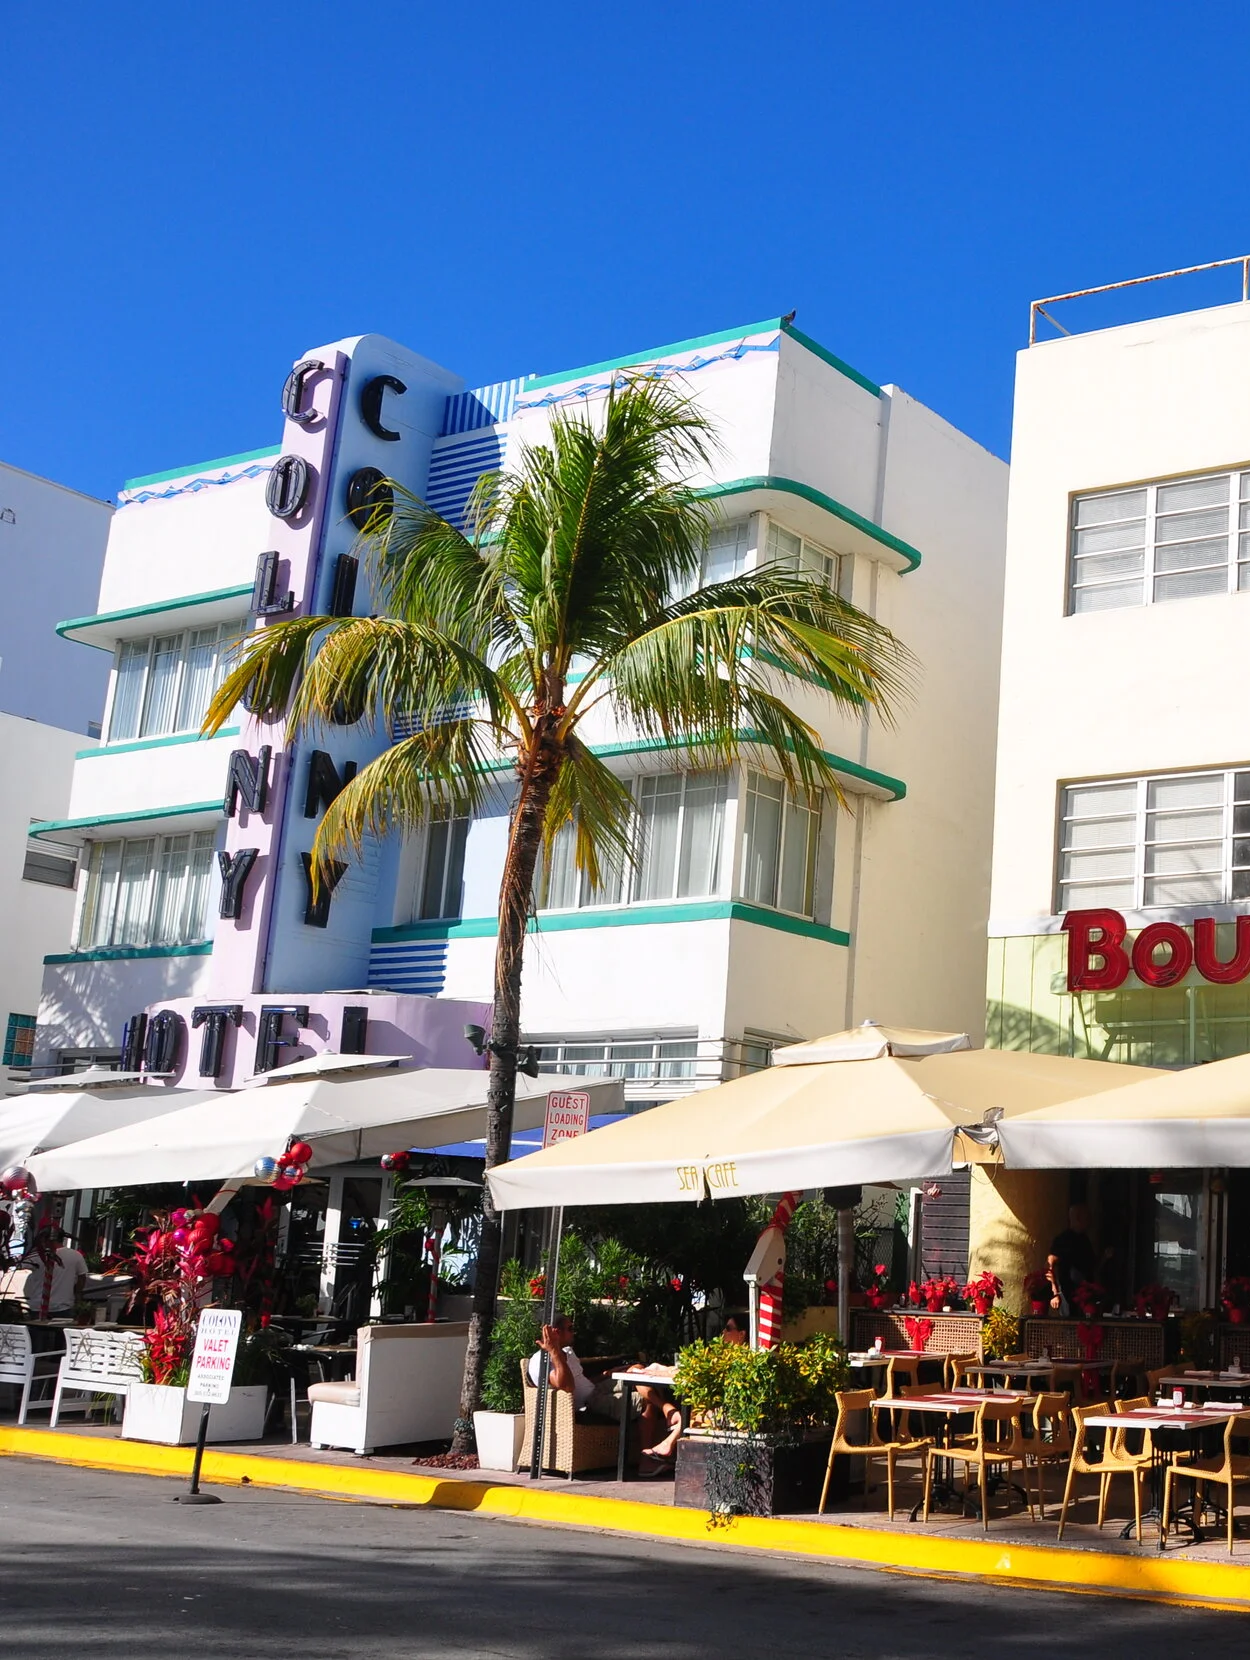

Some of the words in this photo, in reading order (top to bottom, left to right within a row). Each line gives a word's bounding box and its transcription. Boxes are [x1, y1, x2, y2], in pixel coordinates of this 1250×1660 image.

[551, 1096, 585, 1110] GUEST
[549, 1112, 584, 1126] LOADING
[676, 1165, 699, 1191] SEA
[706, 1162, 739, 1188] CAFE
[202, 1315, 238, 1328] COLONY
[200, 1328, 238, 1336] HOTEL
[203, 1339, 229, 1353] VALET
[196, 1355, 231, 1371] PARKING
